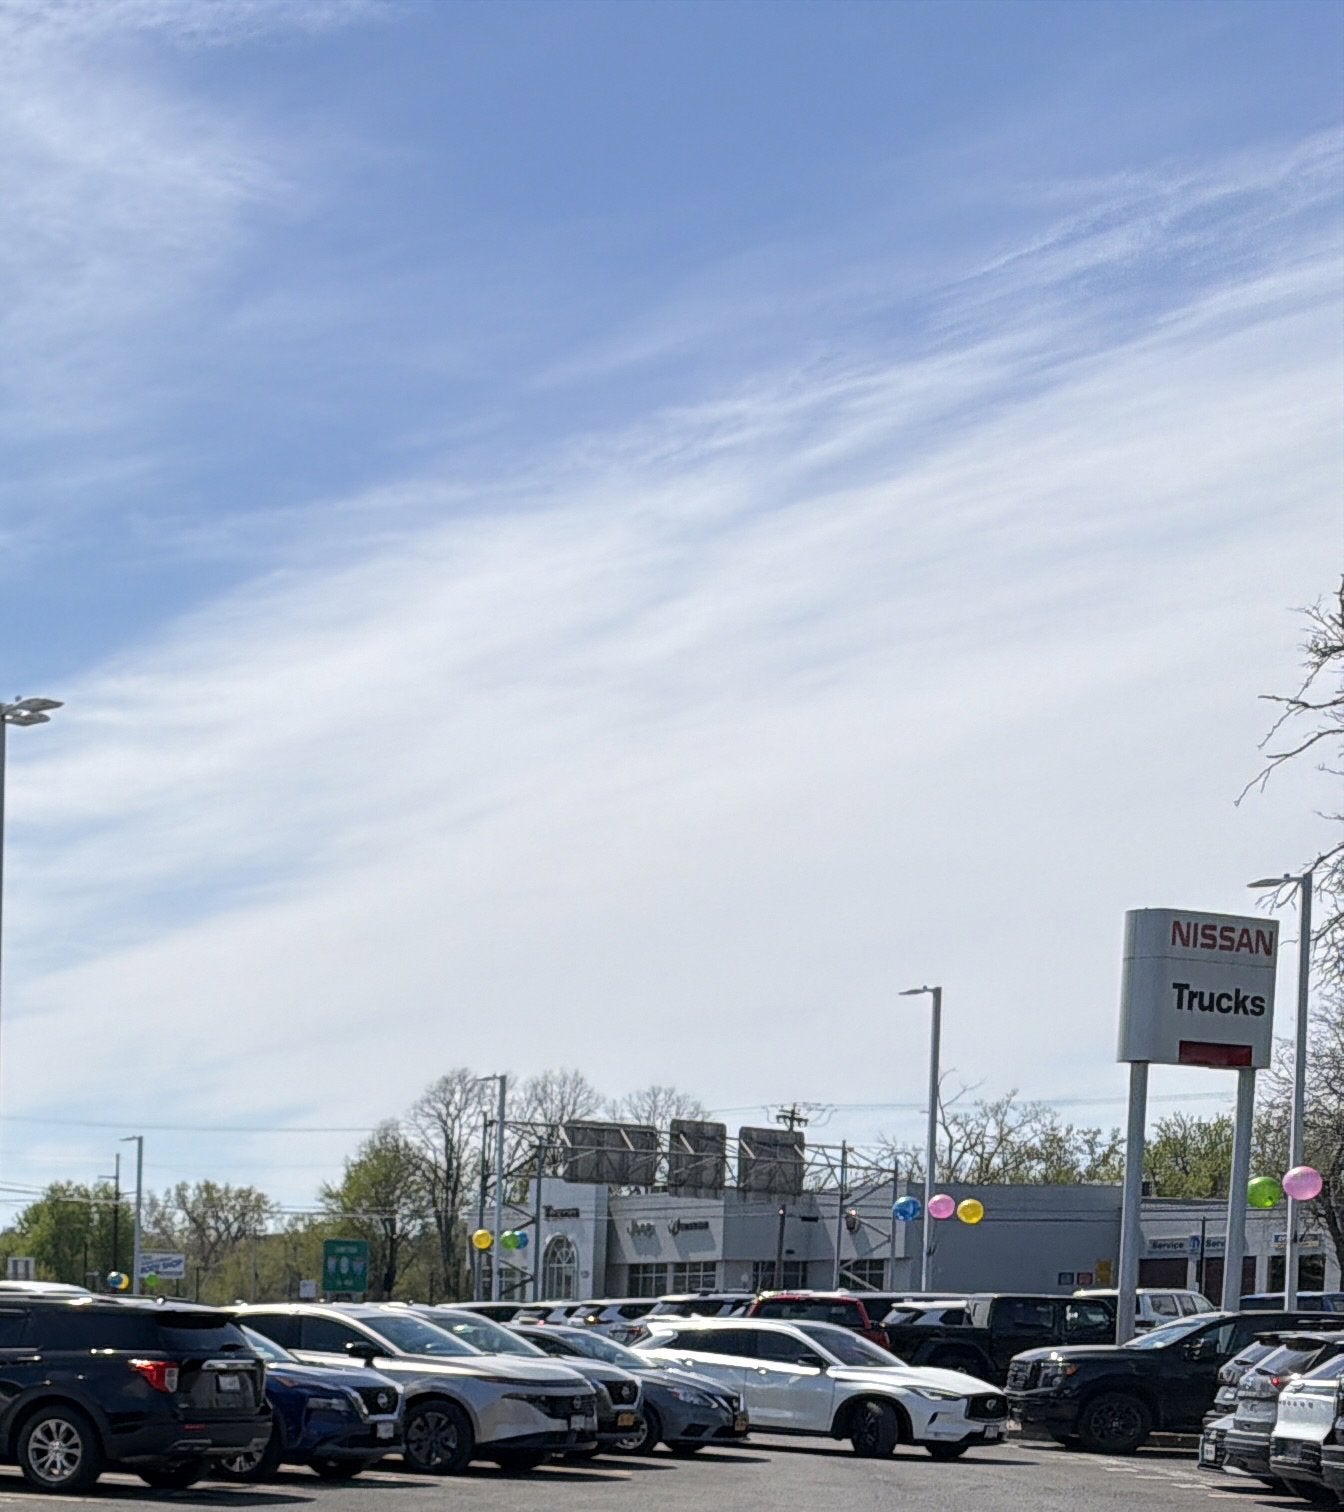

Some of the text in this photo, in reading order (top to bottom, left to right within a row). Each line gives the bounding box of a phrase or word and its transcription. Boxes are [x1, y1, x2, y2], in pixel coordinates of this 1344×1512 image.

[1171, 921, 1274, 956] NISSAN
[1172, 983, 1265, 1016] Trucks
[1152, 1240, 1185, 1250] Service
